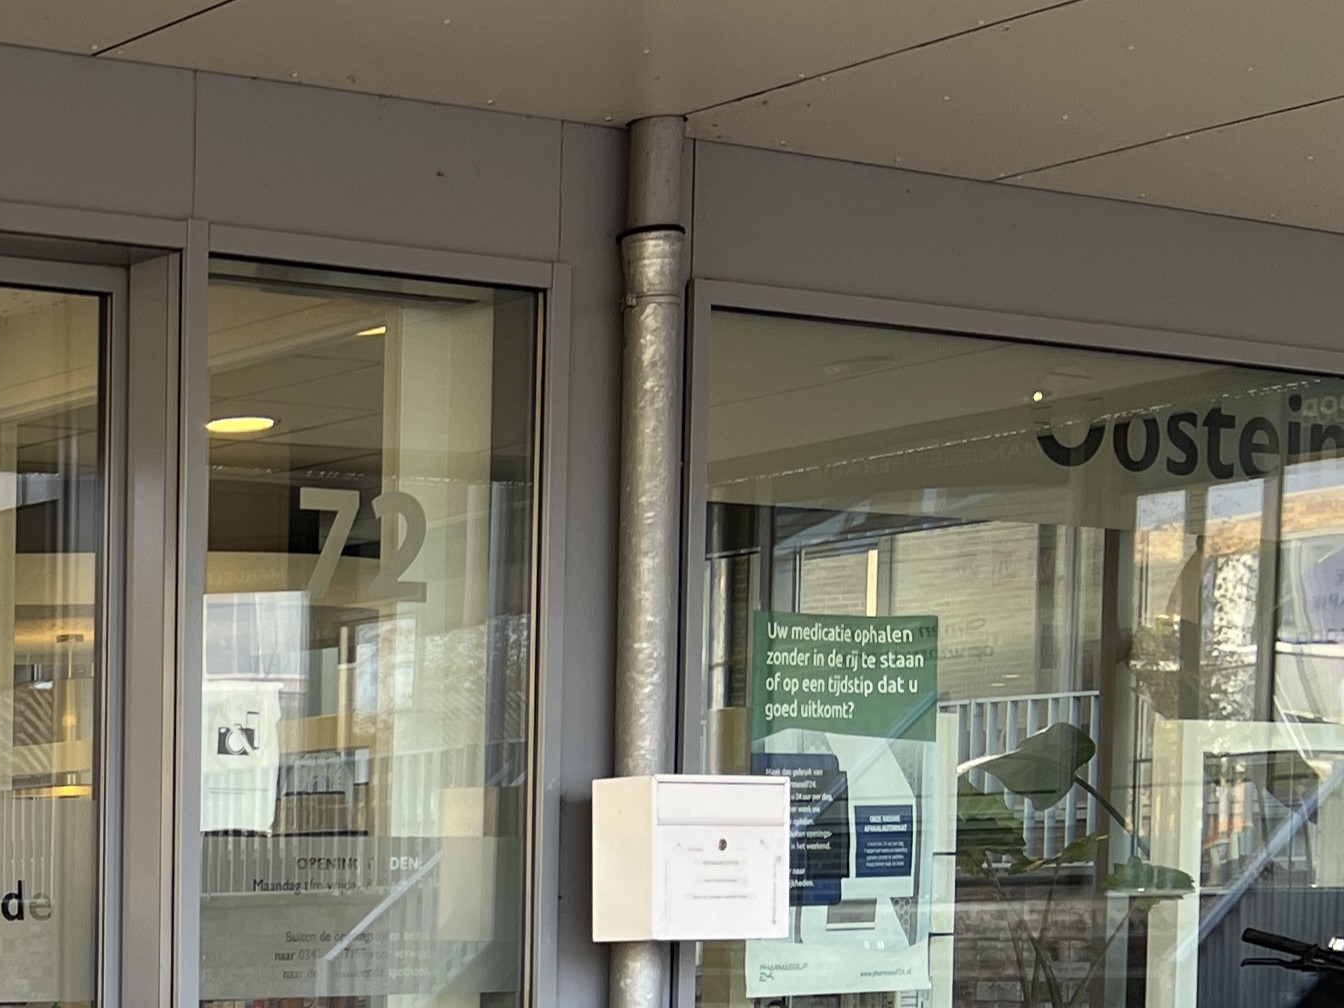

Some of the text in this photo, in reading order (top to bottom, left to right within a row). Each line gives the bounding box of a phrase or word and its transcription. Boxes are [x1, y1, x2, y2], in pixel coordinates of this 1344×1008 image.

[299, 486, 427, 603] 72
[768, 621, 912, 646] Uw medicatie ophalen
[766, 647, 924, 672] zonder in de rij te staan
[766, 672, 918, 697] of op een tijdstip dat u
[765, 699, 855, 721] goed uitkomt?
[252, 879, 302, 895] Maandag
[319, 931, 331, 942] de
[274, 951, 295, 961] naar
[759, 972, 774, 982] 24
